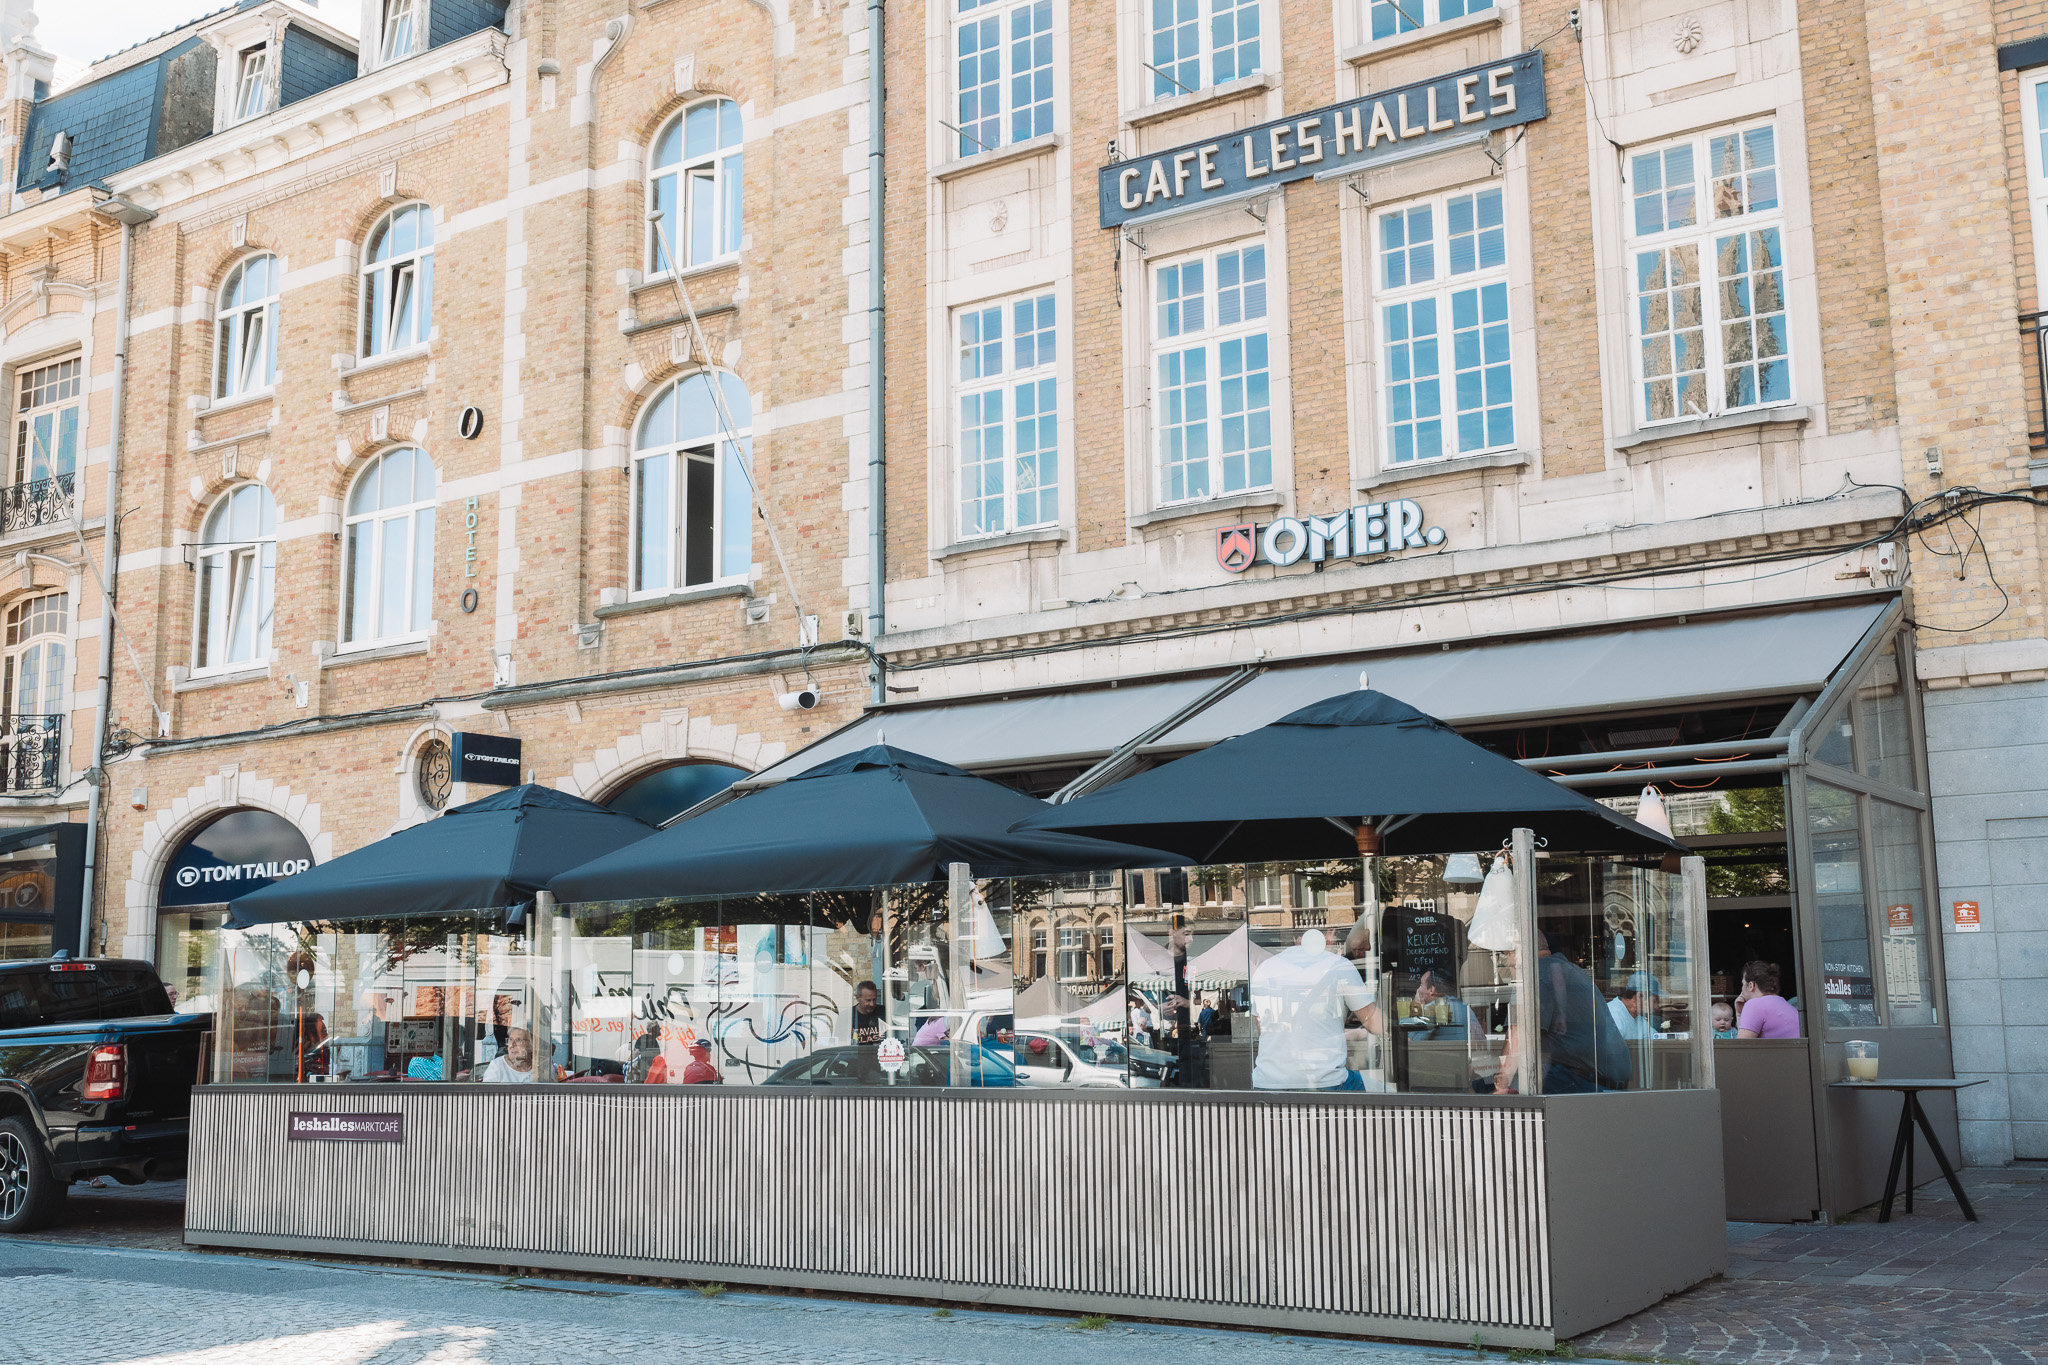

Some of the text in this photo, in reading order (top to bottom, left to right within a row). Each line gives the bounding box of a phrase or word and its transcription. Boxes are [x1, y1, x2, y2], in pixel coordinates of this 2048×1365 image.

[1119, 143, 1225, 210] CAFE
[465, 495, 479, 578] HOTEL
[1262, 498, 1446, 566] OMER.
[201, 858, 311, 883] TOM TAILOR
[1407, 932, 1445, 947] KEUKEN
[1824, 979, 1852, 995] eshalles
